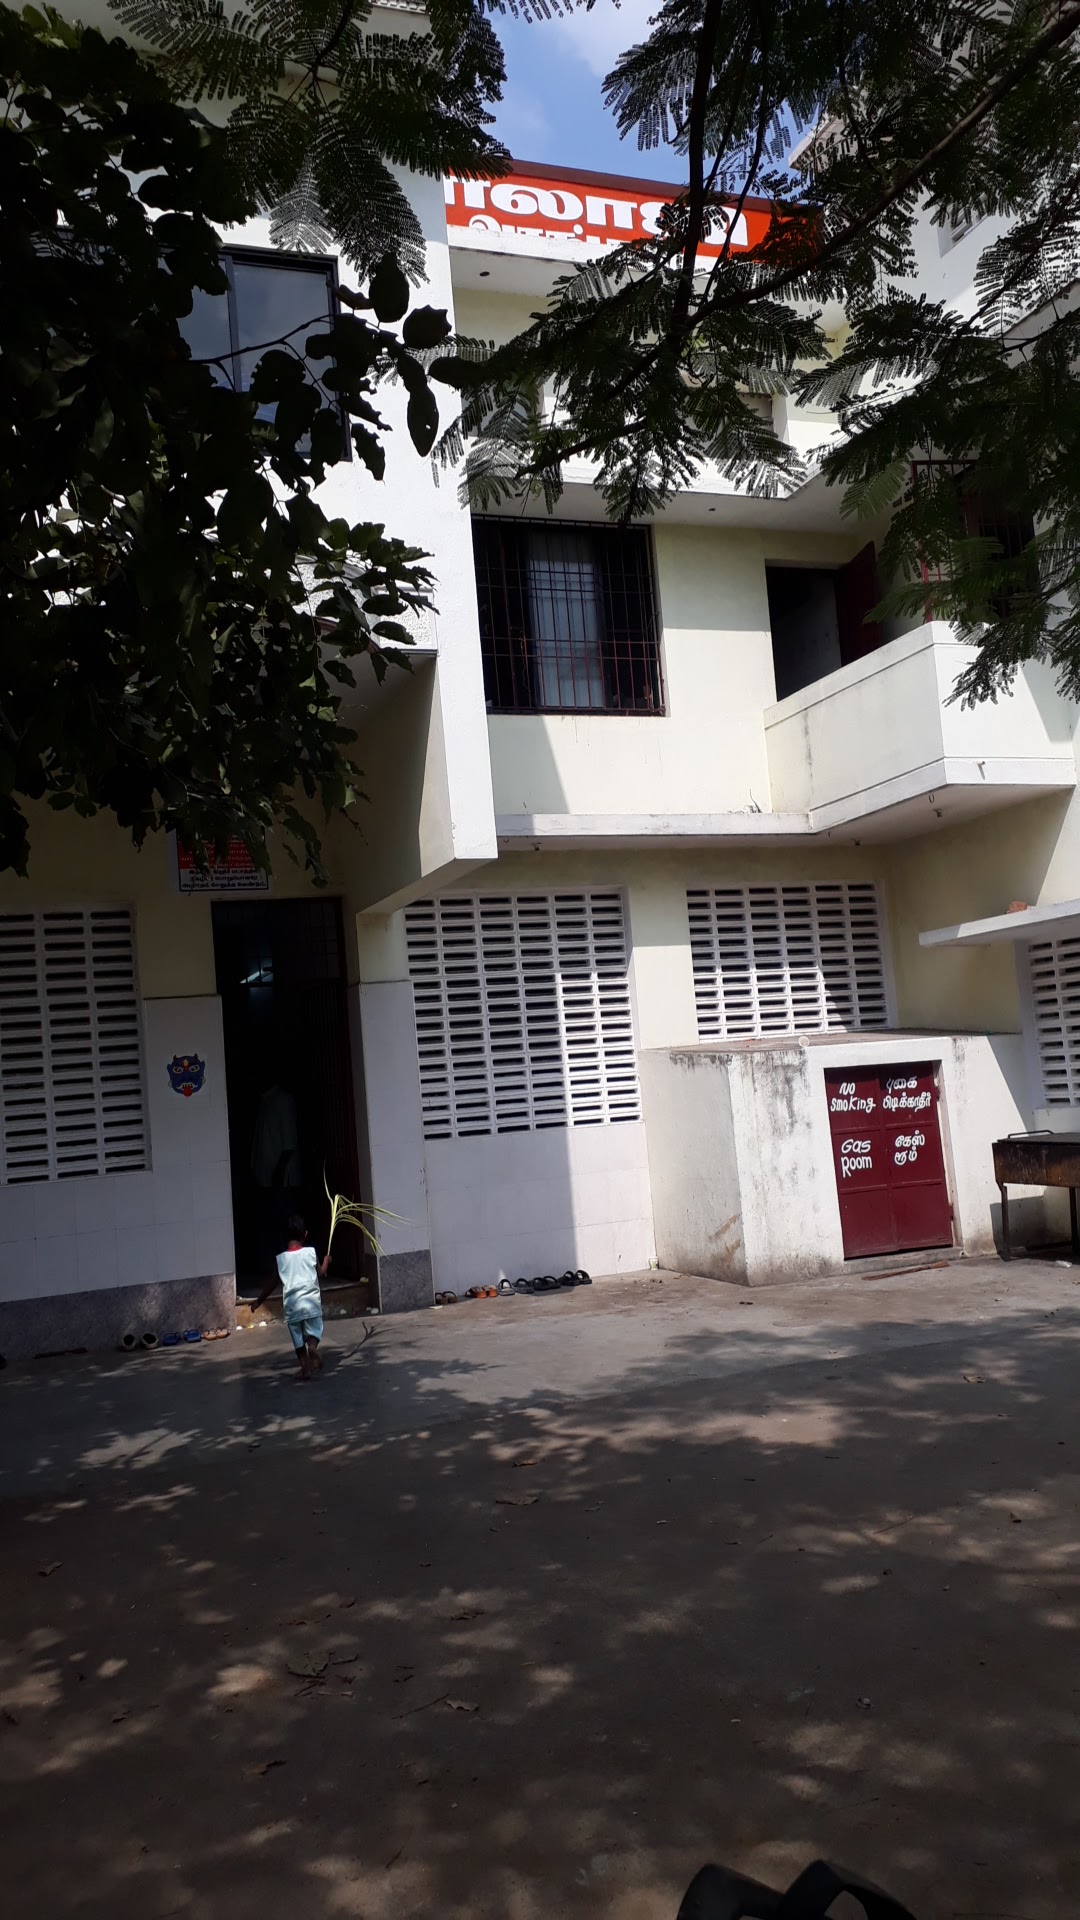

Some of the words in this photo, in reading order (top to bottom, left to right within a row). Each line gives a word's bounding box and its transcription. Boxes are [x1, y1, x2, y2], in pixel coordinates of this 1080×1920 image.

[886, 1075, 918, 1094] புகை
[882, 1091, 932, 1112] பிடிக்காதீர்
[895, 1129, 926, 1148] கேஸ்
[894, 1146, 918, 1166] ரூம்
